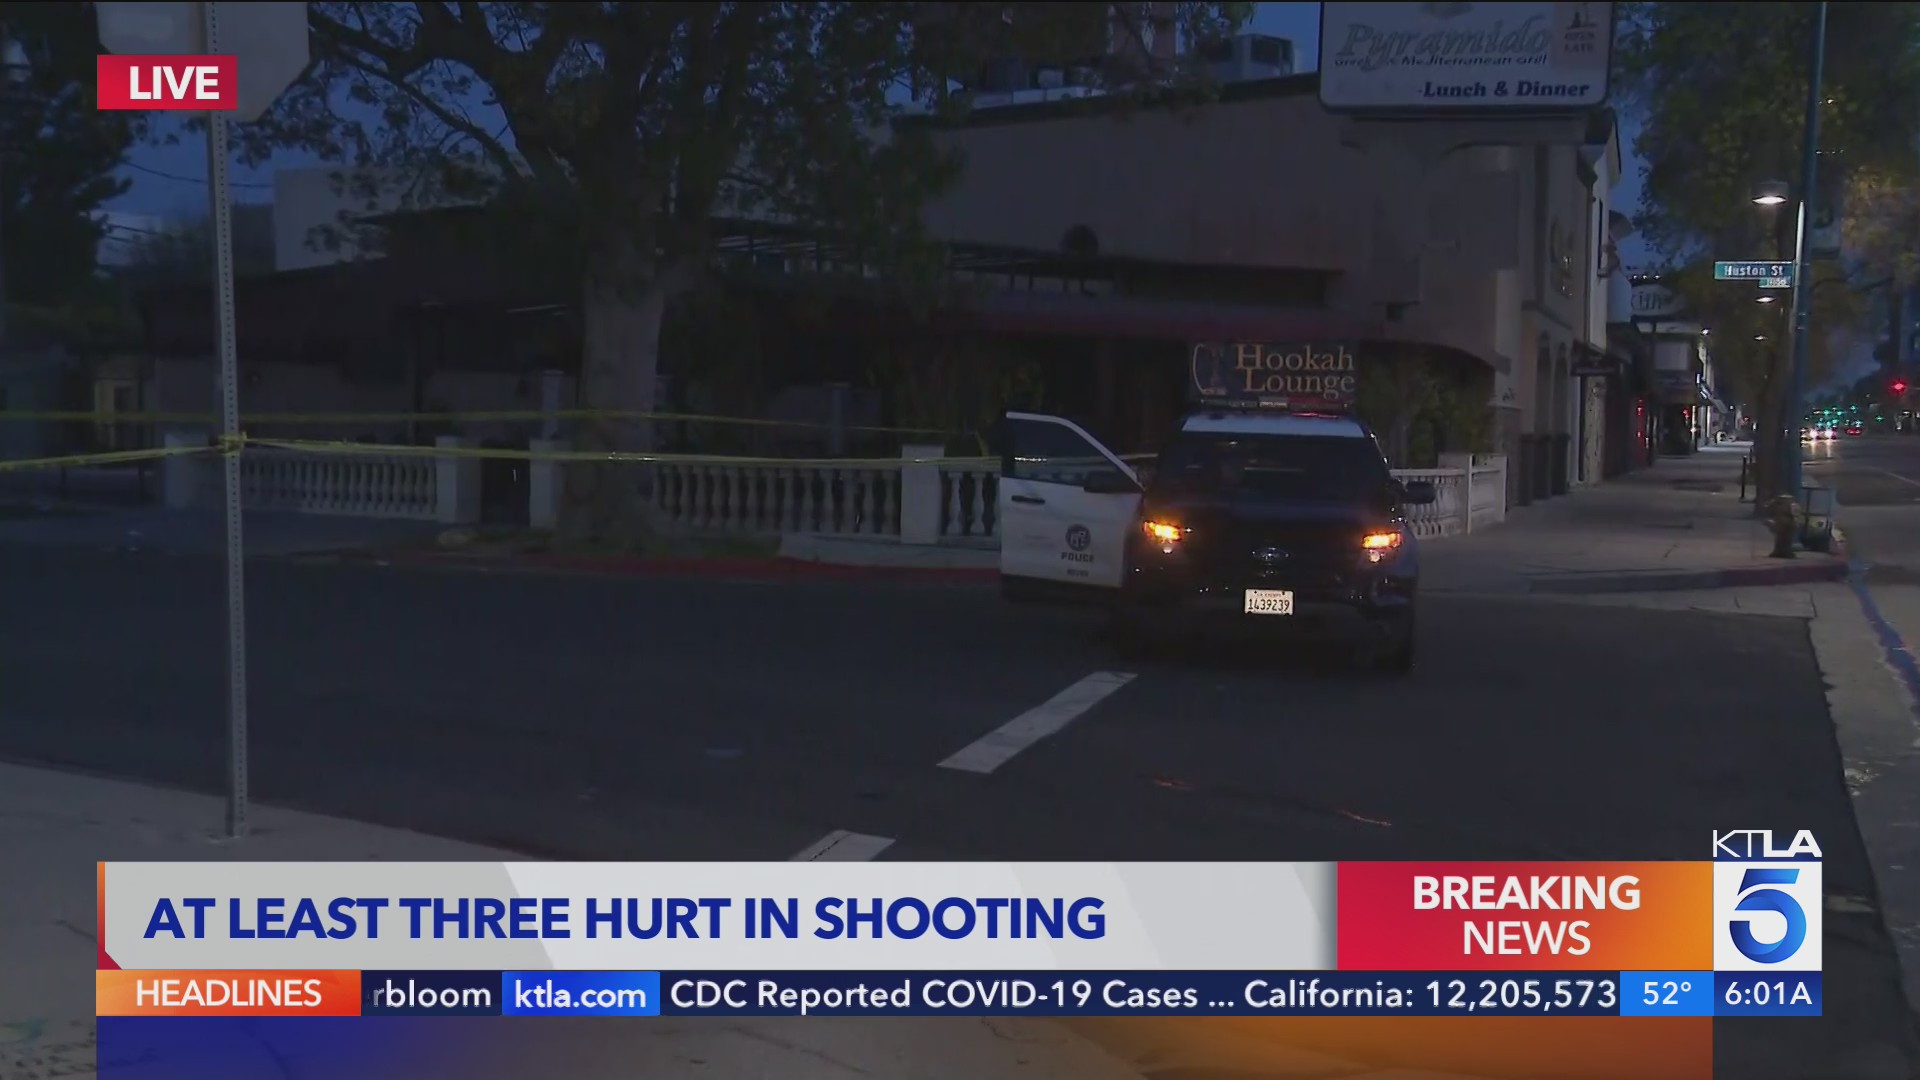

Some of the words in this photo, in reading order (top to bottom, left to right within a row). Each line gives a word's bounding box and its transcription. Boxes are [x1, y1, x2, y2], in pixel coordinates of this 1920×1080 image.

[1494, 80, 1509, 97] &
[1515, 80, 1590, 97] Dinner
[1724, 264, 1766, 276] Huston
[1771, 264, 1784, 276] St
[1235, 343, 1355, 370] Hookah
[1243, 367, 1356, 399] Lounge
[1061, 551, 1095, 562] POLICE
[1248, 598, 1290, 612] 1439239
